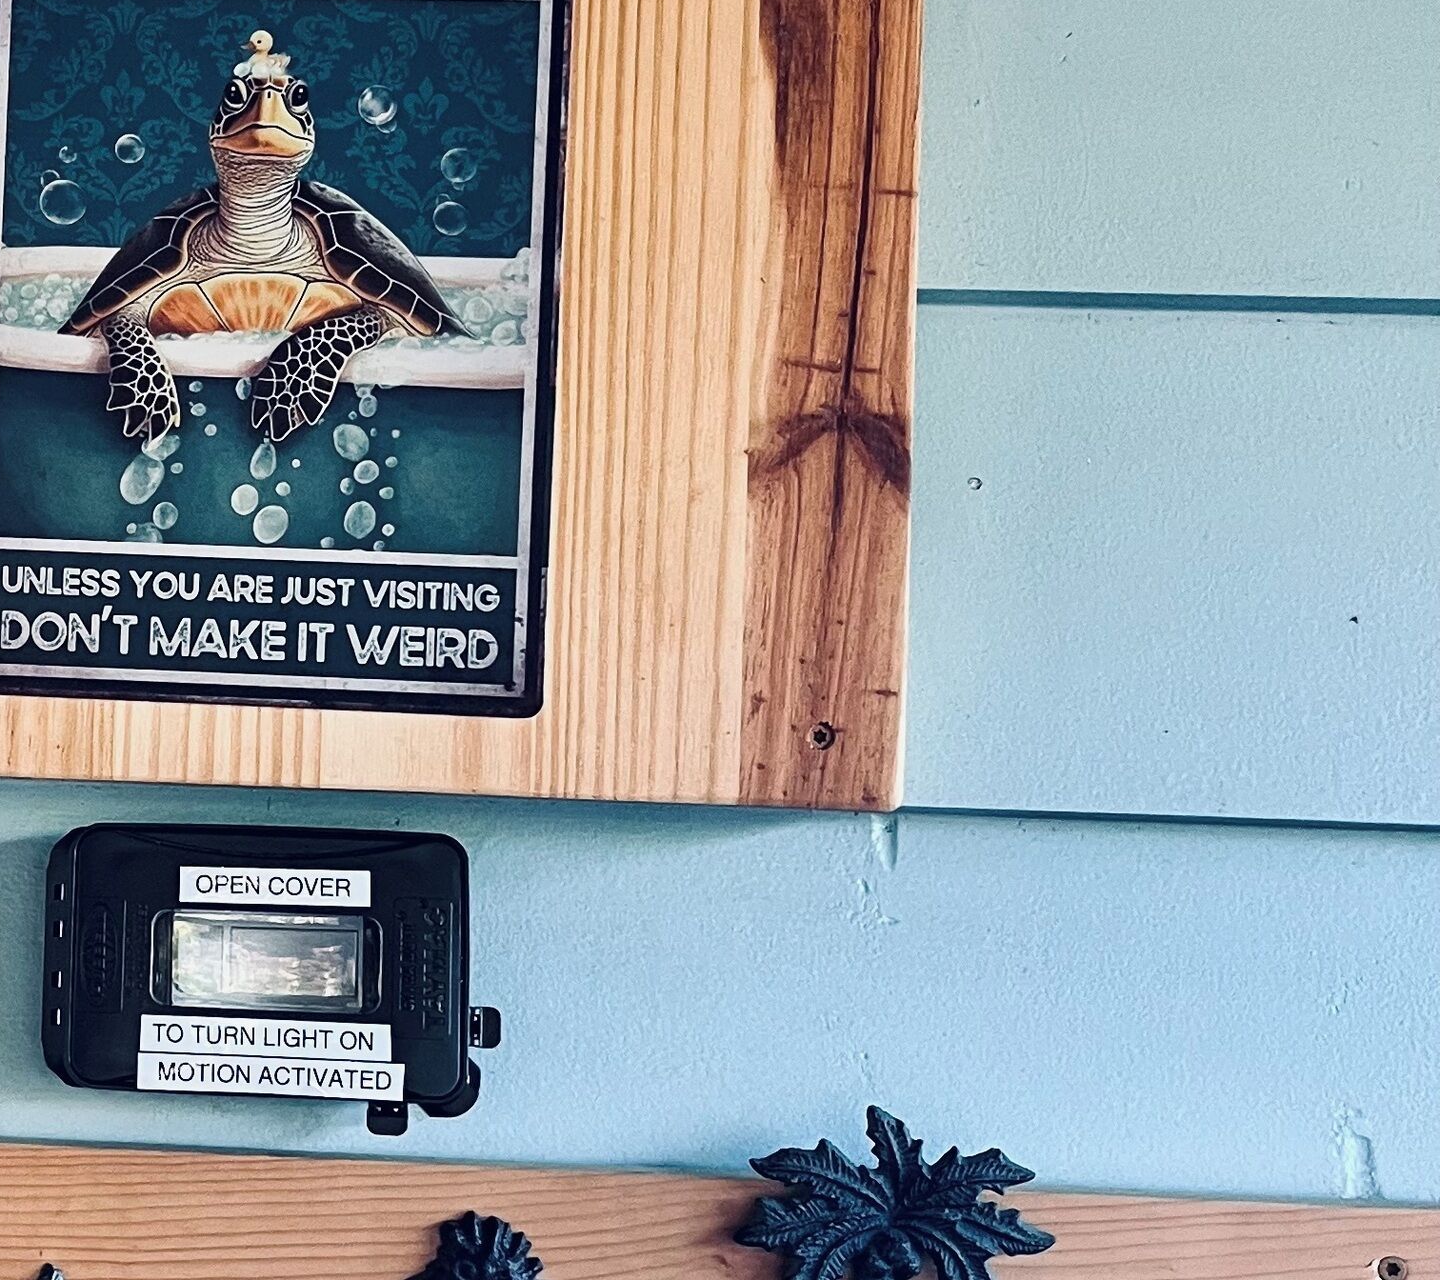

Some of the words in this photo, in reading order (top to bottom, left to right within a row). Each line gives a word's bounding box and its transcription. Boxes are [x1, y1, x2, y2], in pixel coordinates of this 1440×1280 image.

[1, 565, 121, 598] UNLESS
[129, 570, 200, 601] YOU
[206, 573, 273, 604] ARE
[280, 576, 355, 608] JUST
[362, 579, 500, 612] VISITING
[0, 606, 138, 655] DON'T
[149, 615, 285, 662] MAKE
[297, 623, 334, 663] IT
[345, 624, 499, 669] WEIRD
[195, 874, 260, 895] OPEN
[268, 876, 351, 897] COVER
[152, 1023, 184, 1043] TO
[191, 1024, 255, 1046] TURN
[263, 1027, 335, 1050] LIGHT
[339, 1029, 374, 1052] ON
[158, 1061, 250, 1085] MOTION
[258, 1065, 392, 1091] ACTIVATED
